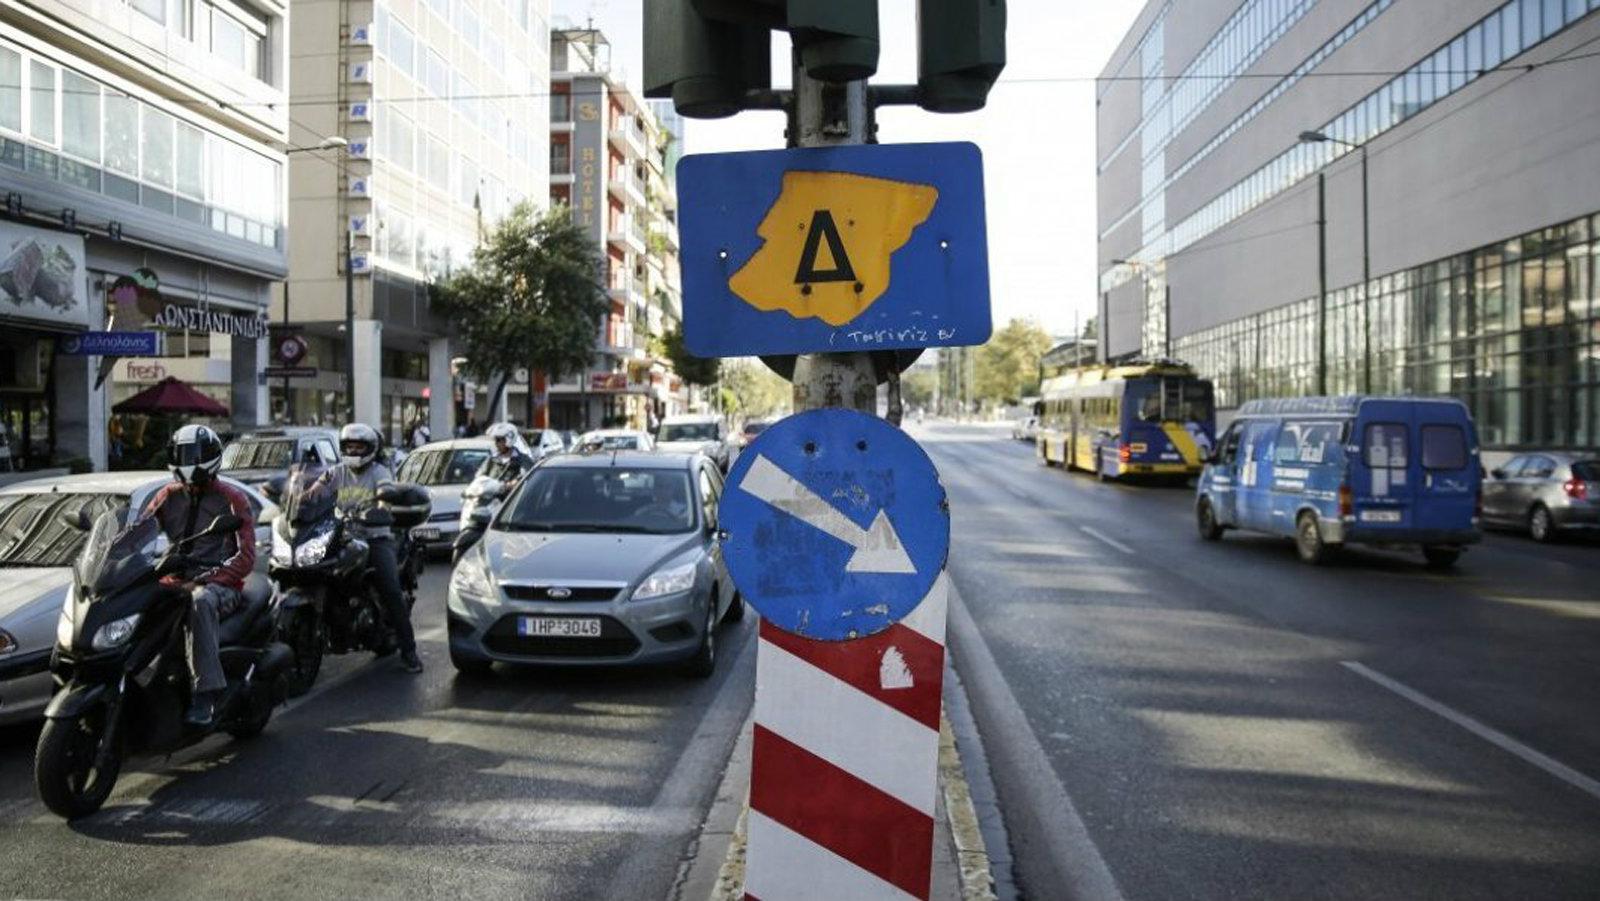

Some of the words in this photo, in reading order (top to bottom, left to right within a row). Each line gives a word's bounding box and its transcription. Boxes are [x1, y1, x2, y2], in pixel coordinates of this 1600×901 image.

[349, 28, 368, 269] AIRWAYS
[794, 209, 857, 284] Δ
[127, 361, 166, 379] fresh
